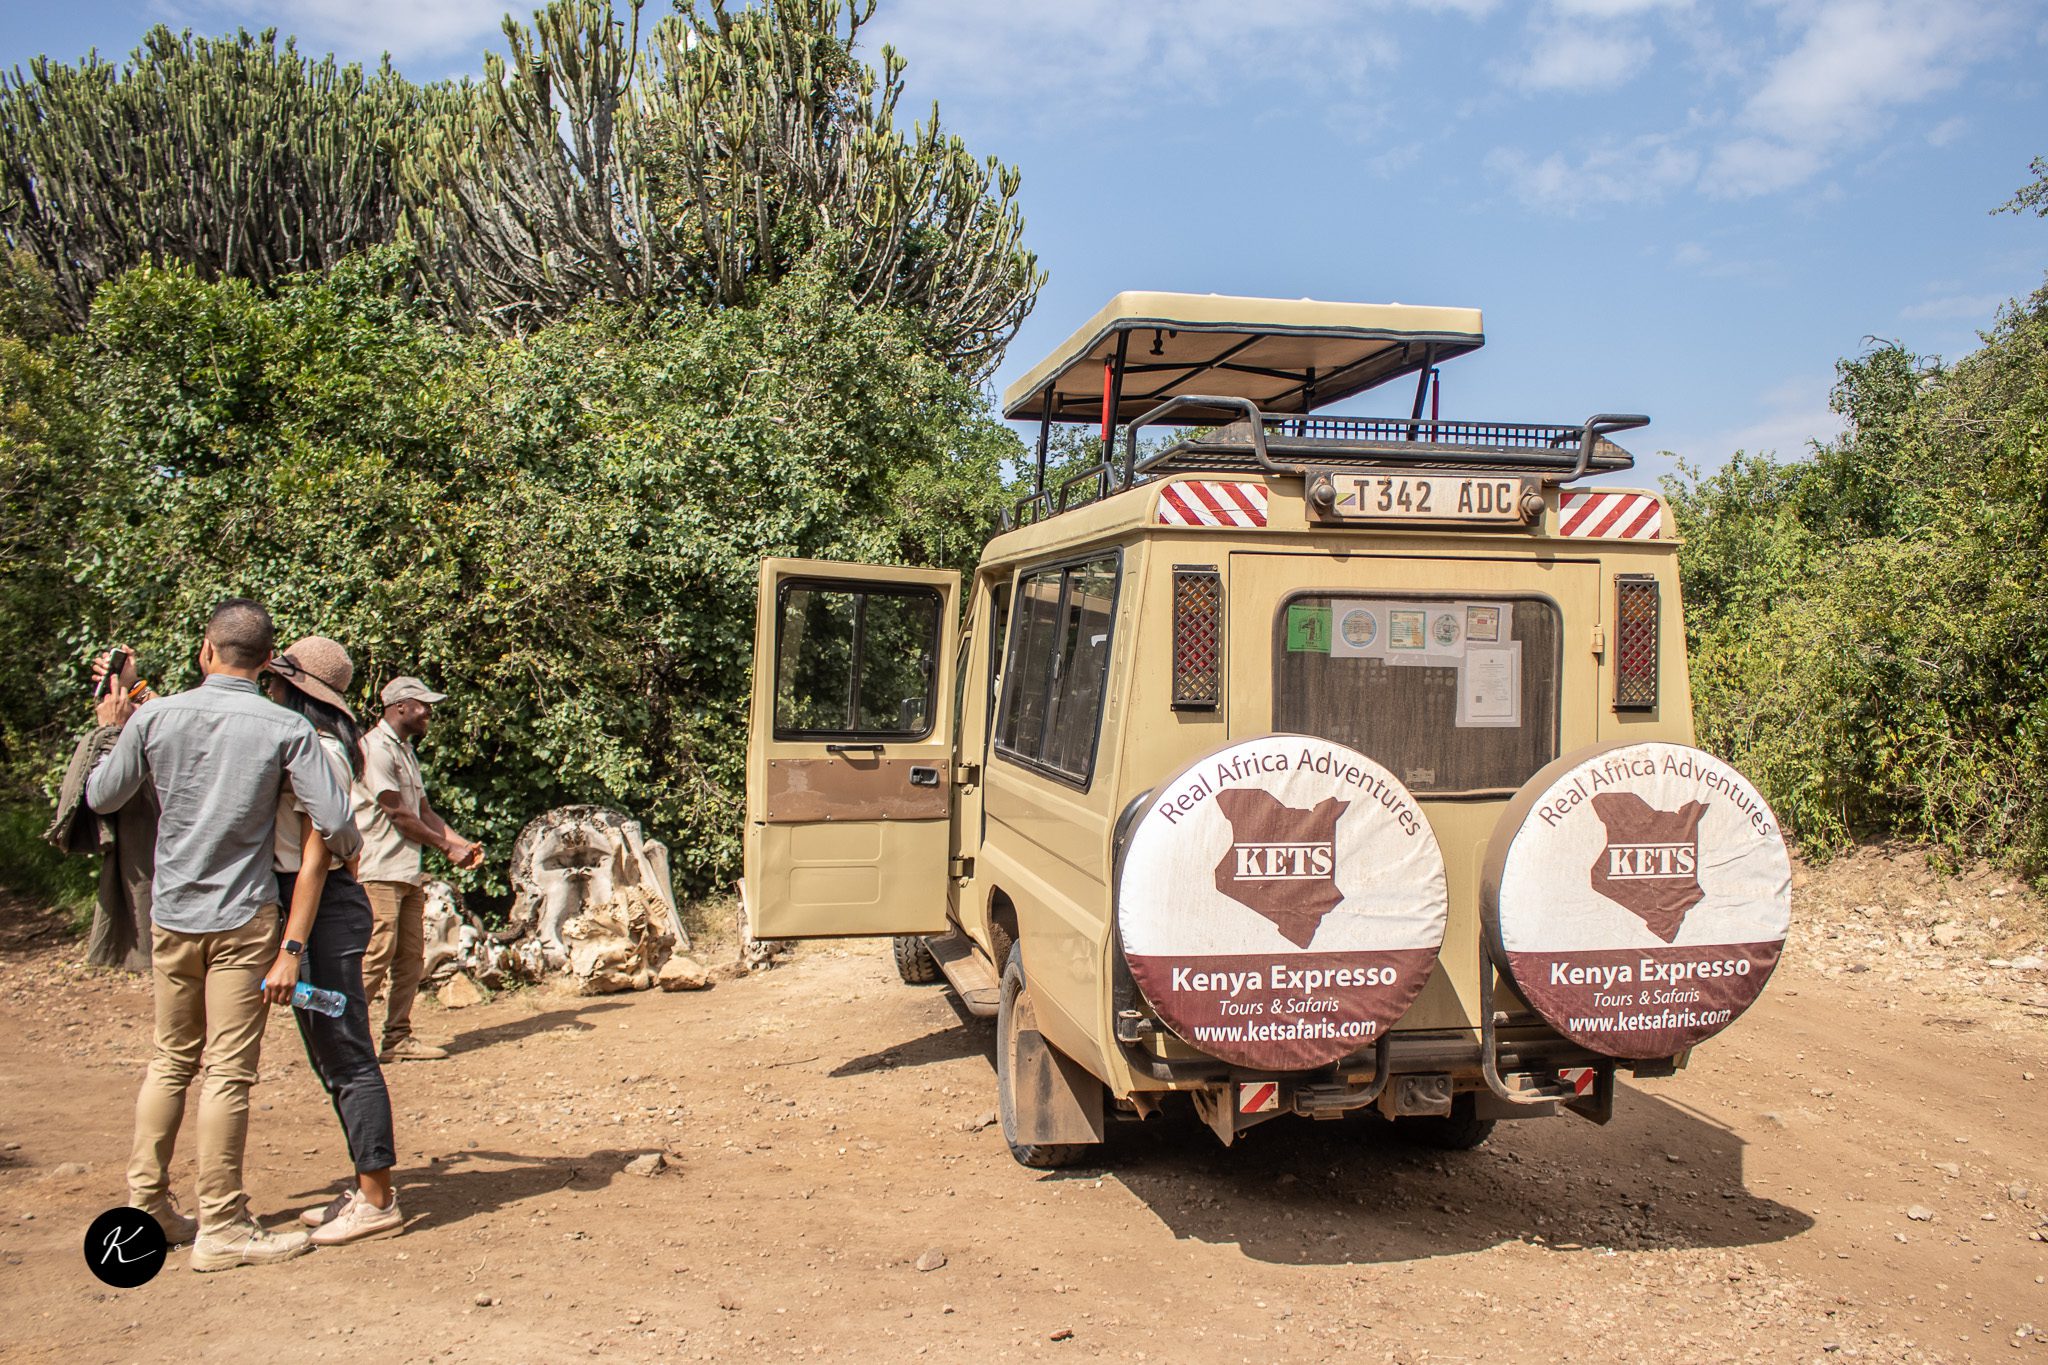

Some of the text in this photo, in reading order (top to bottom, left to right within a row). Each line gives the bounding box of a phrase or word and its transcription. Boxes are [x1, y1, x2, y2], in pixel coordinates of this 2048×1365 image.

[1458, 481, 1512, 513] ADC
[1159, 748, 1421, 837] Real Africa Adventures
[1538, 754, 1772, 836] Real Africa Adventures
[1234, 846, 1333, 877] KETS
[1608, 847, 1694, 876] KETS
[1171, 965, 1397, 996] Kenya Expresso
[1550, 959, 1751, 989] Kenya Expresso
[1219, 996, 1340, 1016] Tours & Safaris
[1593, 988, 1700, 1008] Tours & Safaris
[1194, 1017, 1377, 1042] www.ketsafaris.com
[1569, 1007, 1732, 1033] www.ketsafaris.com
